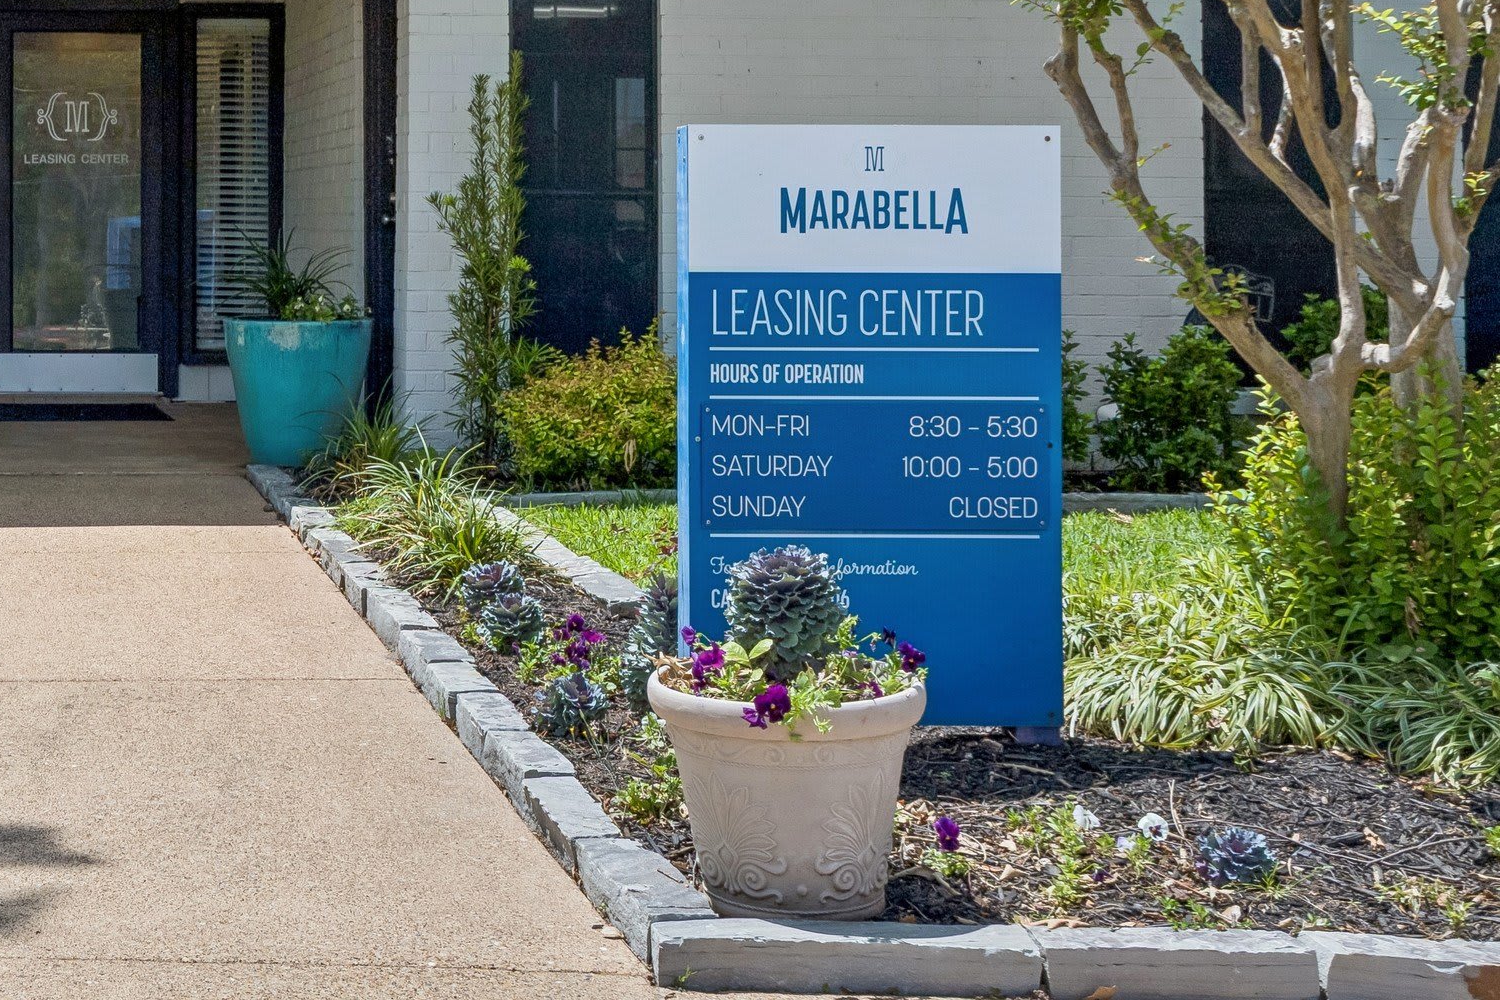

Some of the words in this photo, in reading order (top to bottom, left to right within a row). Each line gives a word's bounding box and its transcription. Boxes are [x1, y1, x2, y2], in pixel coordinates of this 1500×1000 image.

[24, 154, 76, 164] LEASING
[81, 154, 129, 164] CENTER
[864, 146, 885, 172] M
[780, 187, 969, 234] MARABELLA
[712, 289, 847, 336] LEASING
[859, 290, 985, 337] CENTER
[710, 364, 759, 384] HOURS
[763, 364, 781, 384] OF
[784, 364, 865, 384] OPERATION
[712, 415, 810, 436] MON-FRI
[909, 416, 961, 437] 8:30
[986, 416, 1038, 438] 5:30
[712, 455, 833, 477] SATURDAY
[902, 456, 961, 478] 10:00
[987, 456, 1038, 478] 5:00
[712, 496, 806, 517] SUNDAY
[949, 497, 1038, 518] CLOSED
